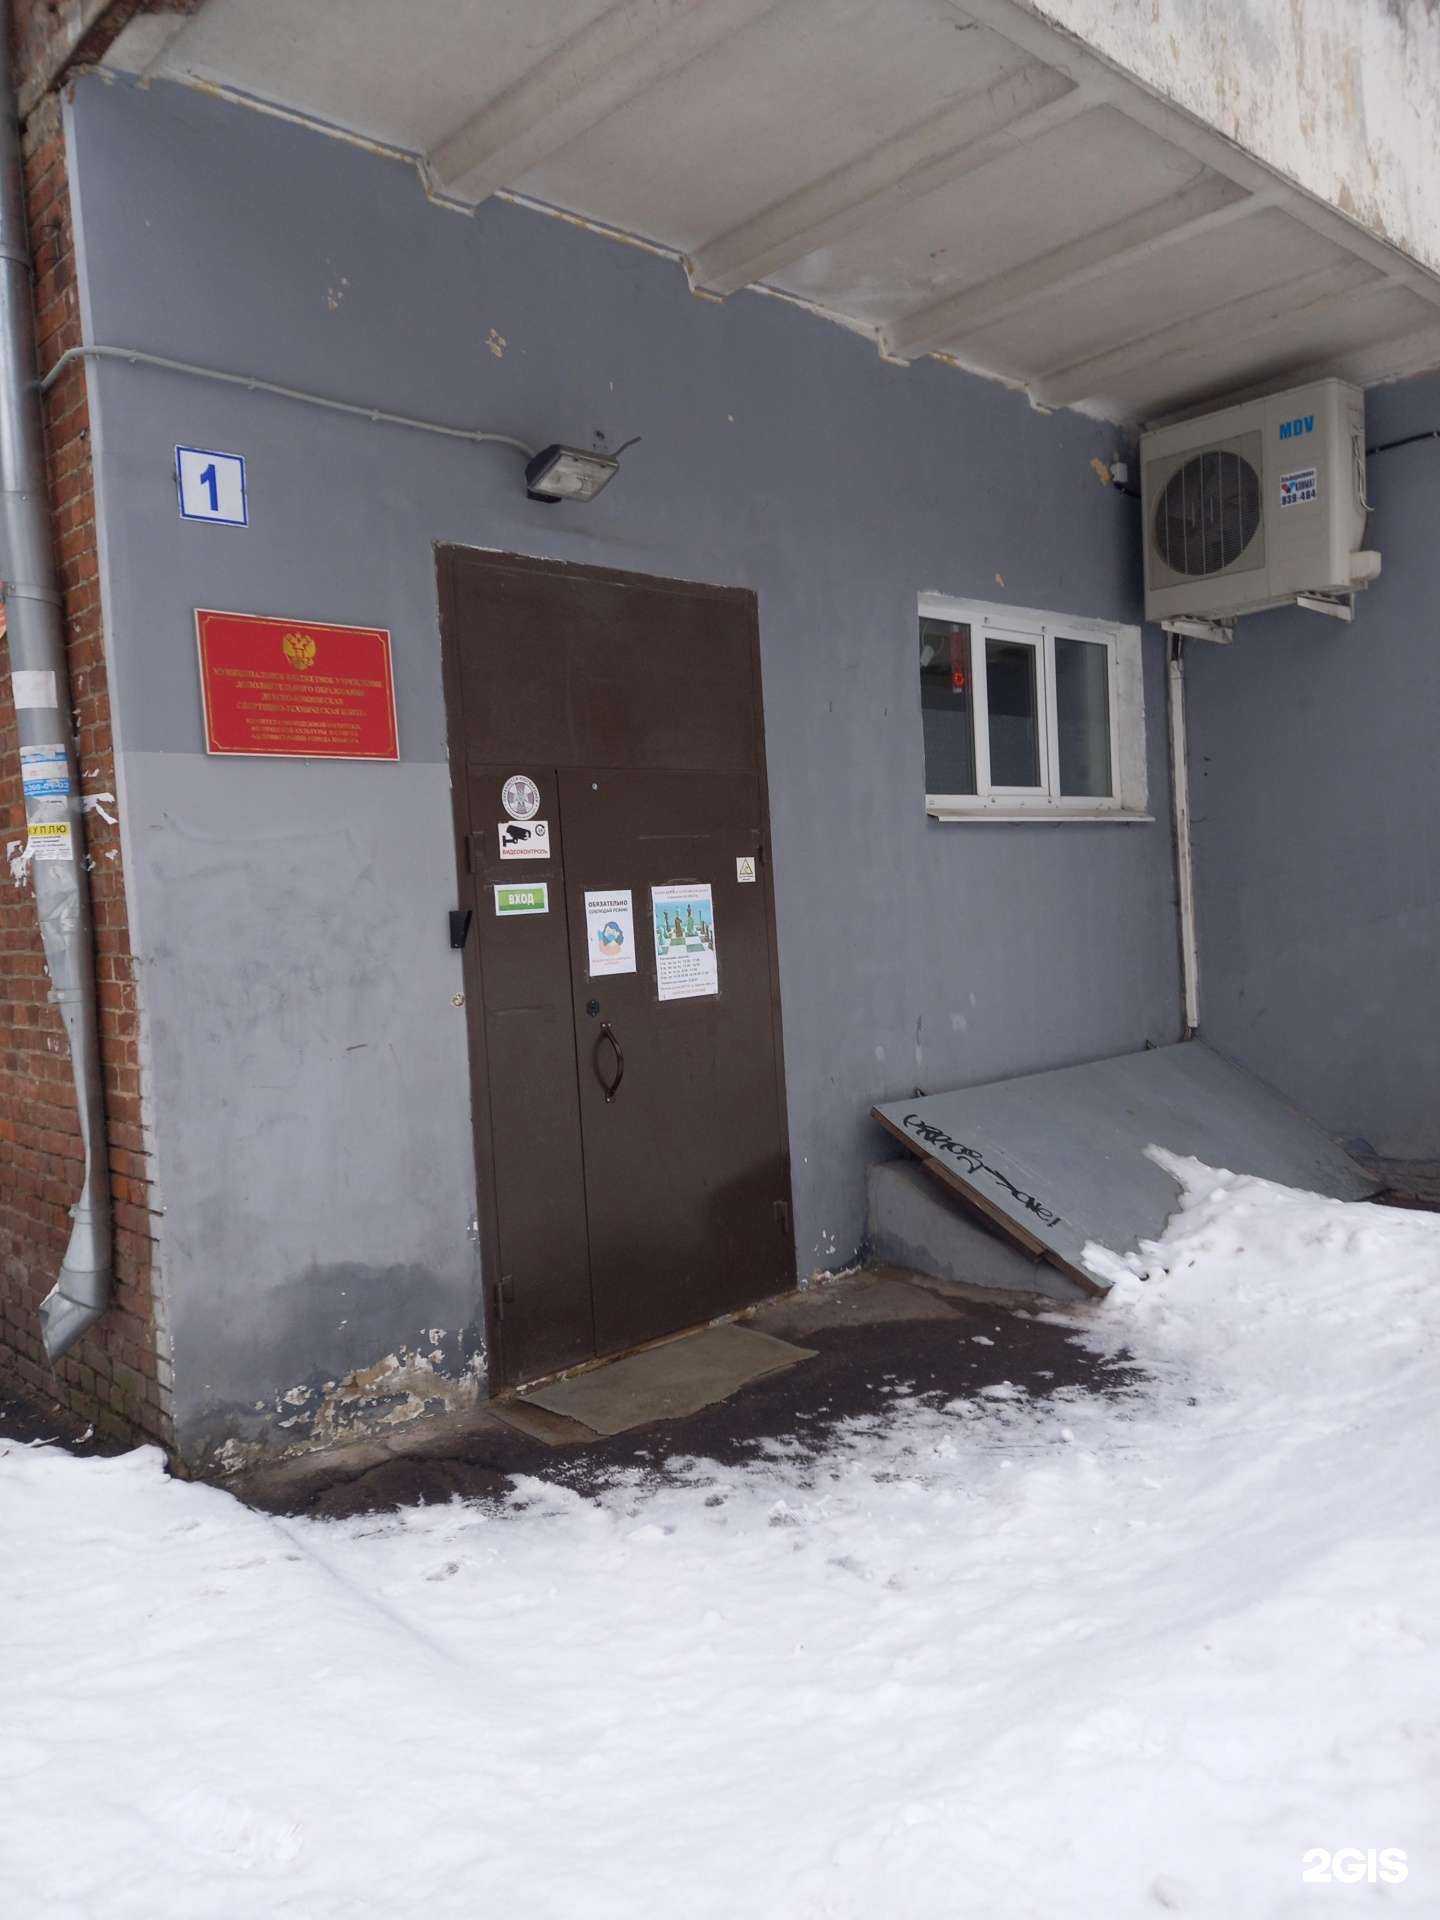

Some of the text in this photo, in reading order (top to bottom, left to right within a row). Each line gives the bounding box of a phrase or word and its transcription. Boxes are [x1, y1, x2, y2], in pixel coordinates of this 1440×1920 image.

[1280, 415, 1314, 440] MDV
[200, 464, 219, 511] 1
[508, 893, 535, 906] ВХОД
[588, 900, 628, 908] ОБЯЗАТЕЛЬНО
